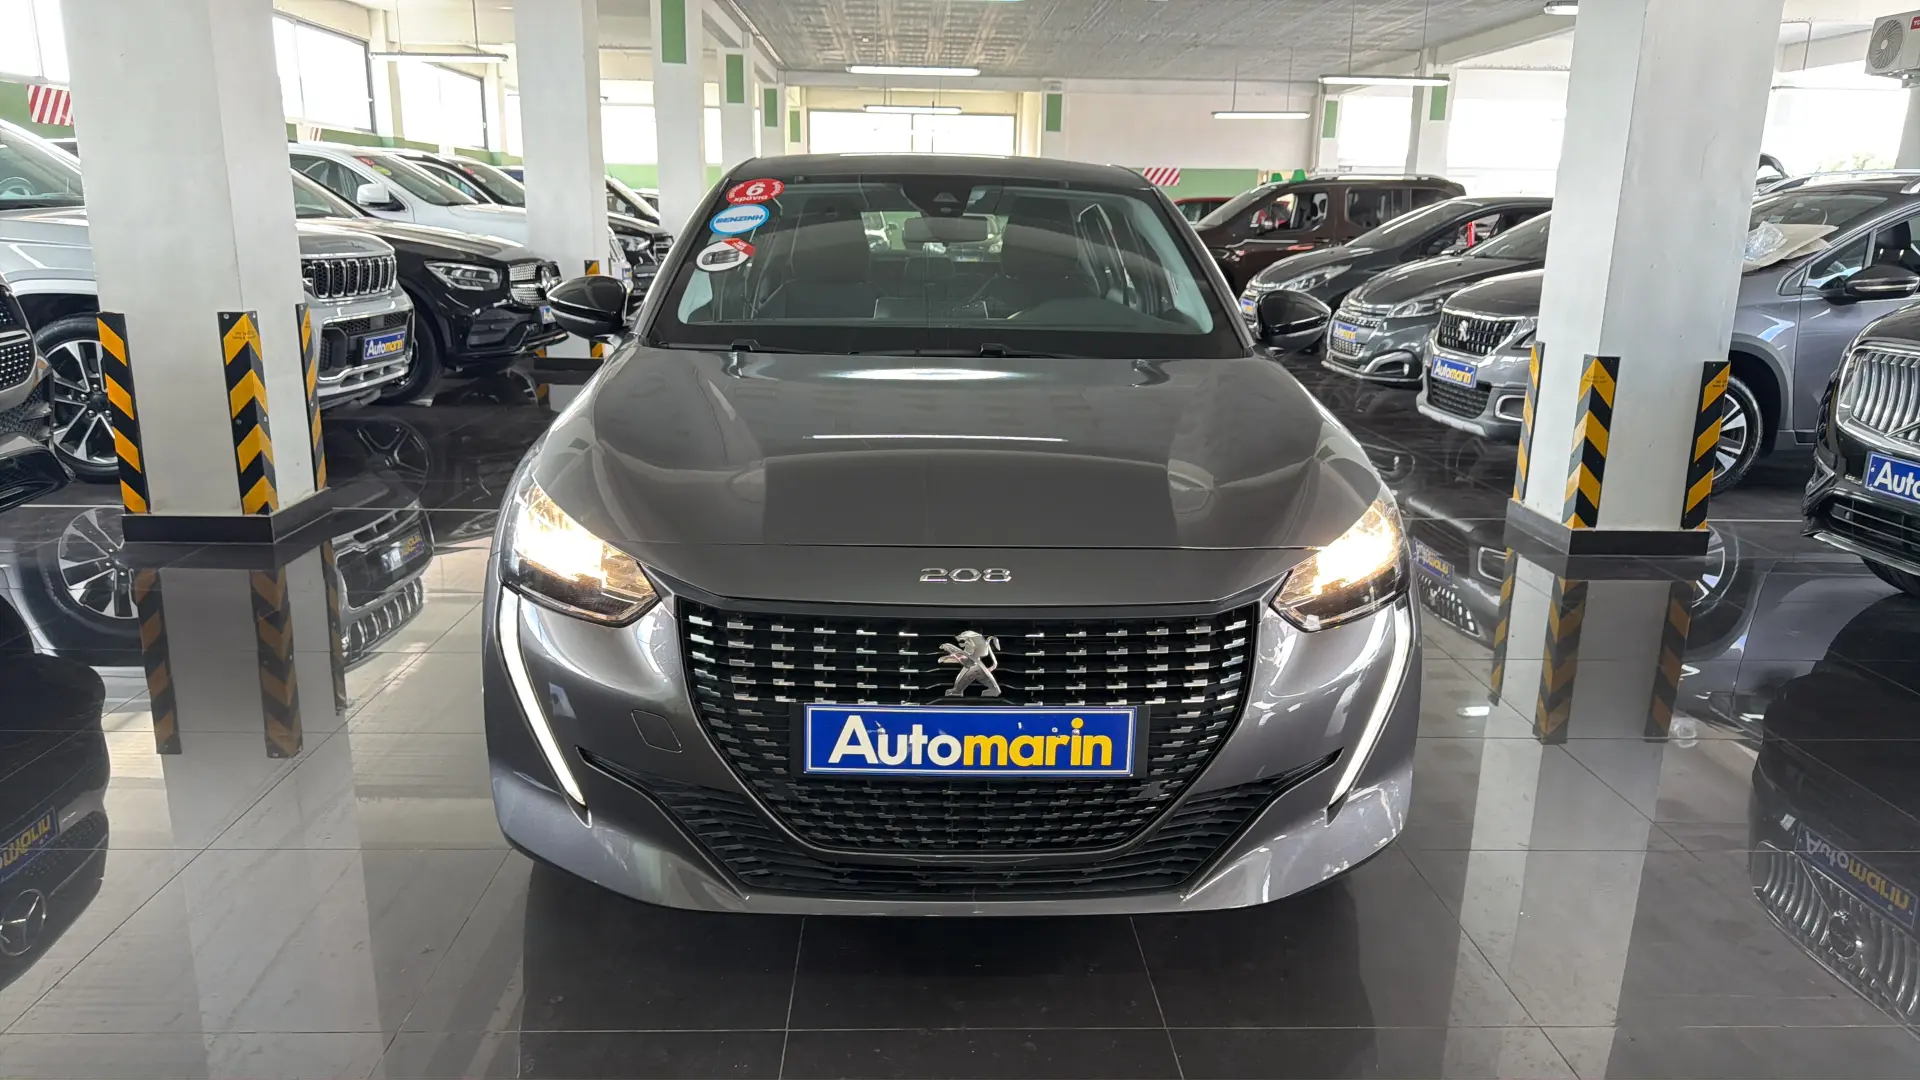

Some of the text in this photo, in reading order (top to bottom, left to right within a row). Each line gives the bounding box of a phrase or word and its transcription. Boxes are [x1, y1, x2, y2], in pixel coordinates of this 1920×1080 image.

[746, 183, 766, 196] 6
[919, 568, 1012, 583] 208
[828, 714, 1113, 767] Automarin
